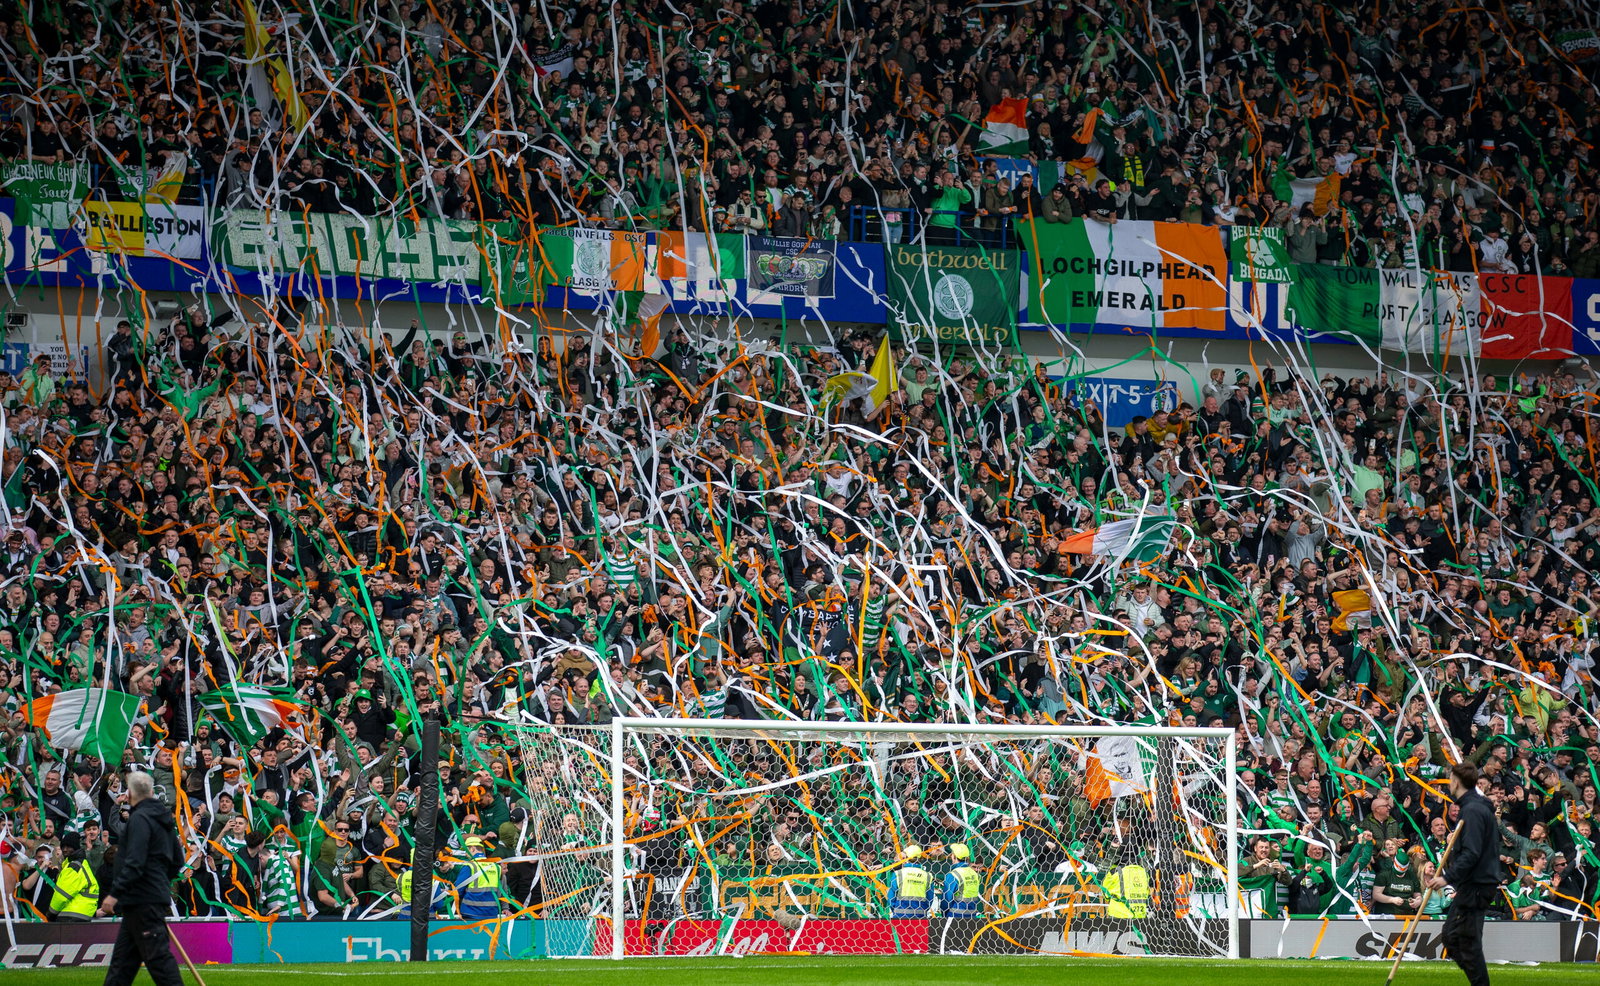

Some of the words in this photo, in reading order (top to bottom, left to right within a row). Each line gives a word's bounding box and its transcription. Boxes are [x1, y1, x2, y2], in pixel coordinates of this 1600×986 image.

[88, 210, 201, 236] BAILLIESTON
[226, 209, 479, 279] BHOYS
[791, 241, 821, 249] GORAN
[1040, 257, 1216, 282] LOCHGILPHEAD
[1333, 268, 1374, 285] TOM
[1382, 270, 1471, 292] WILIAMS
[1485, 276, 1526, 294] CSC
[1071, 290, 1186, 310] EMERALD
[1362, 302, 1409, 322] PORT
[1417, 307, 1508, 328] GLASGOW
[1077, 383, 1122, 403] EXIT
[1128, 385, 1141, 405] 5
[655, 876, 701, 892] BAND
[341, 937, 485, 962] Ebry
